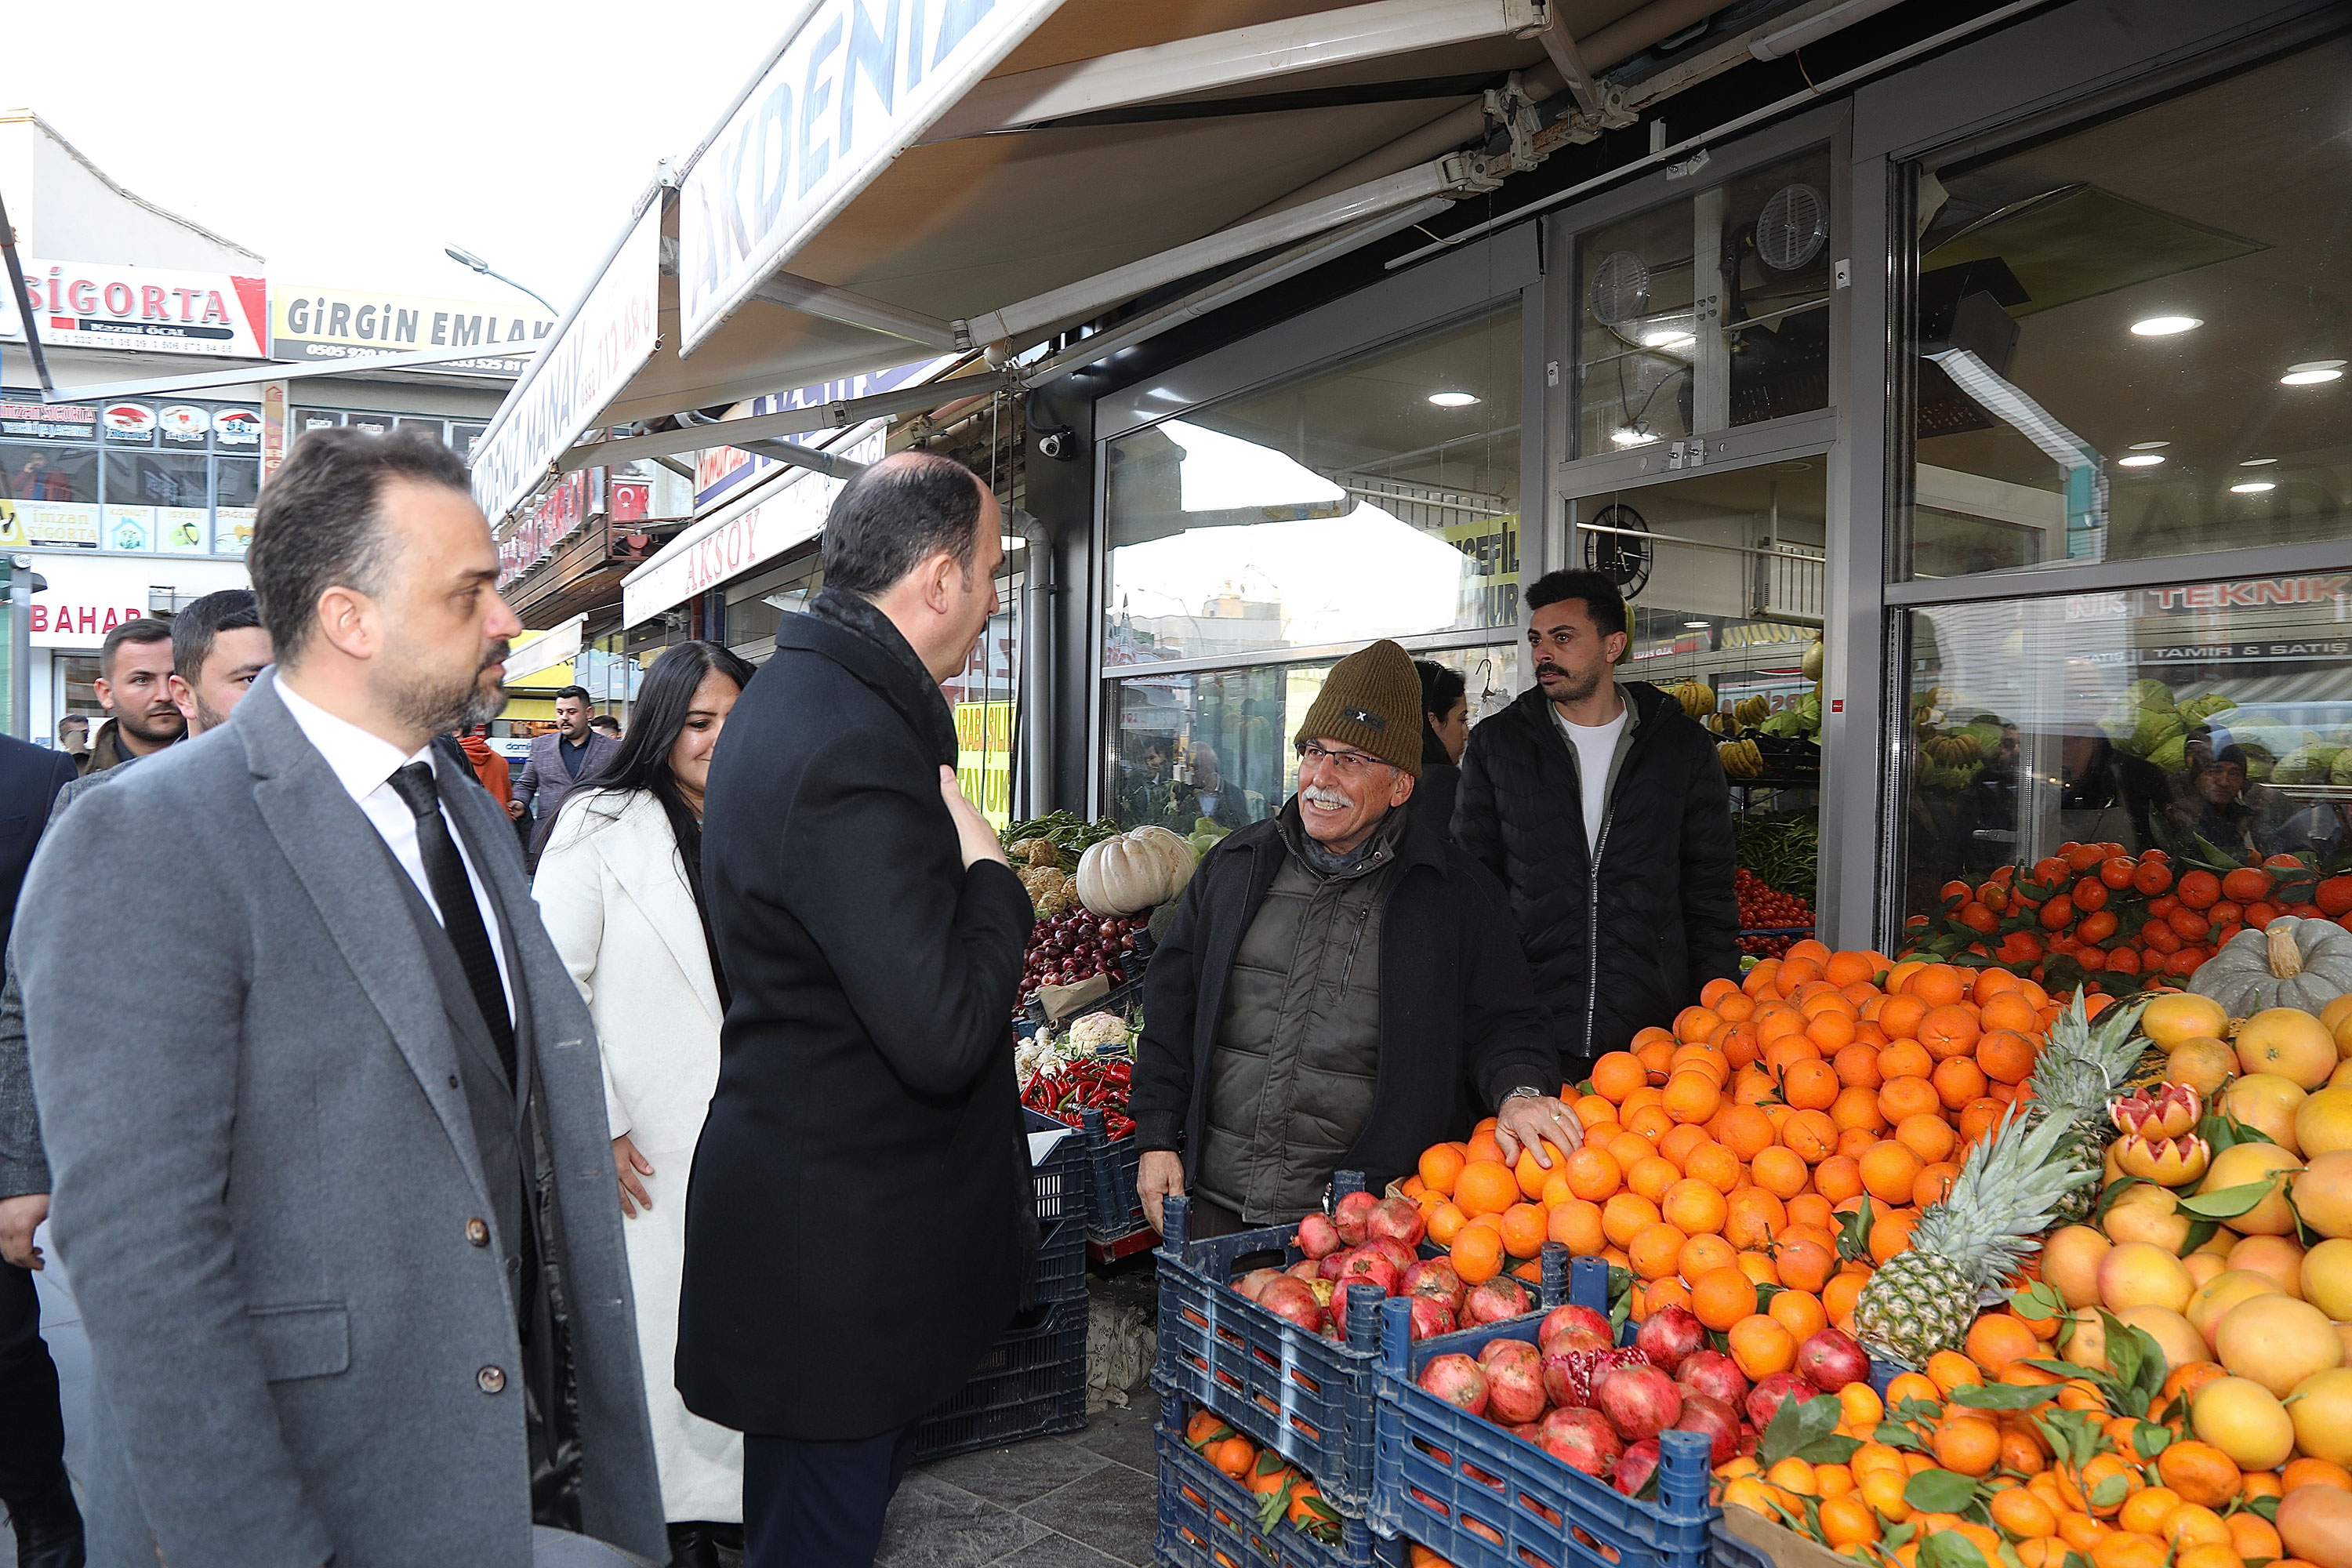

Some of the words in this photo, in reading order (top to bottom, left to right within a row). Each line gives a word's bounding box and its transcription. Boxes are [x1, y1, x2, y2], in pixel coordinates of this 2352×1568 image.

[21, 267, 232, 325] SİGORTA
[288, 298, 419, 343] GİRGİN
[685, 508, 760, 594] AKSOY
